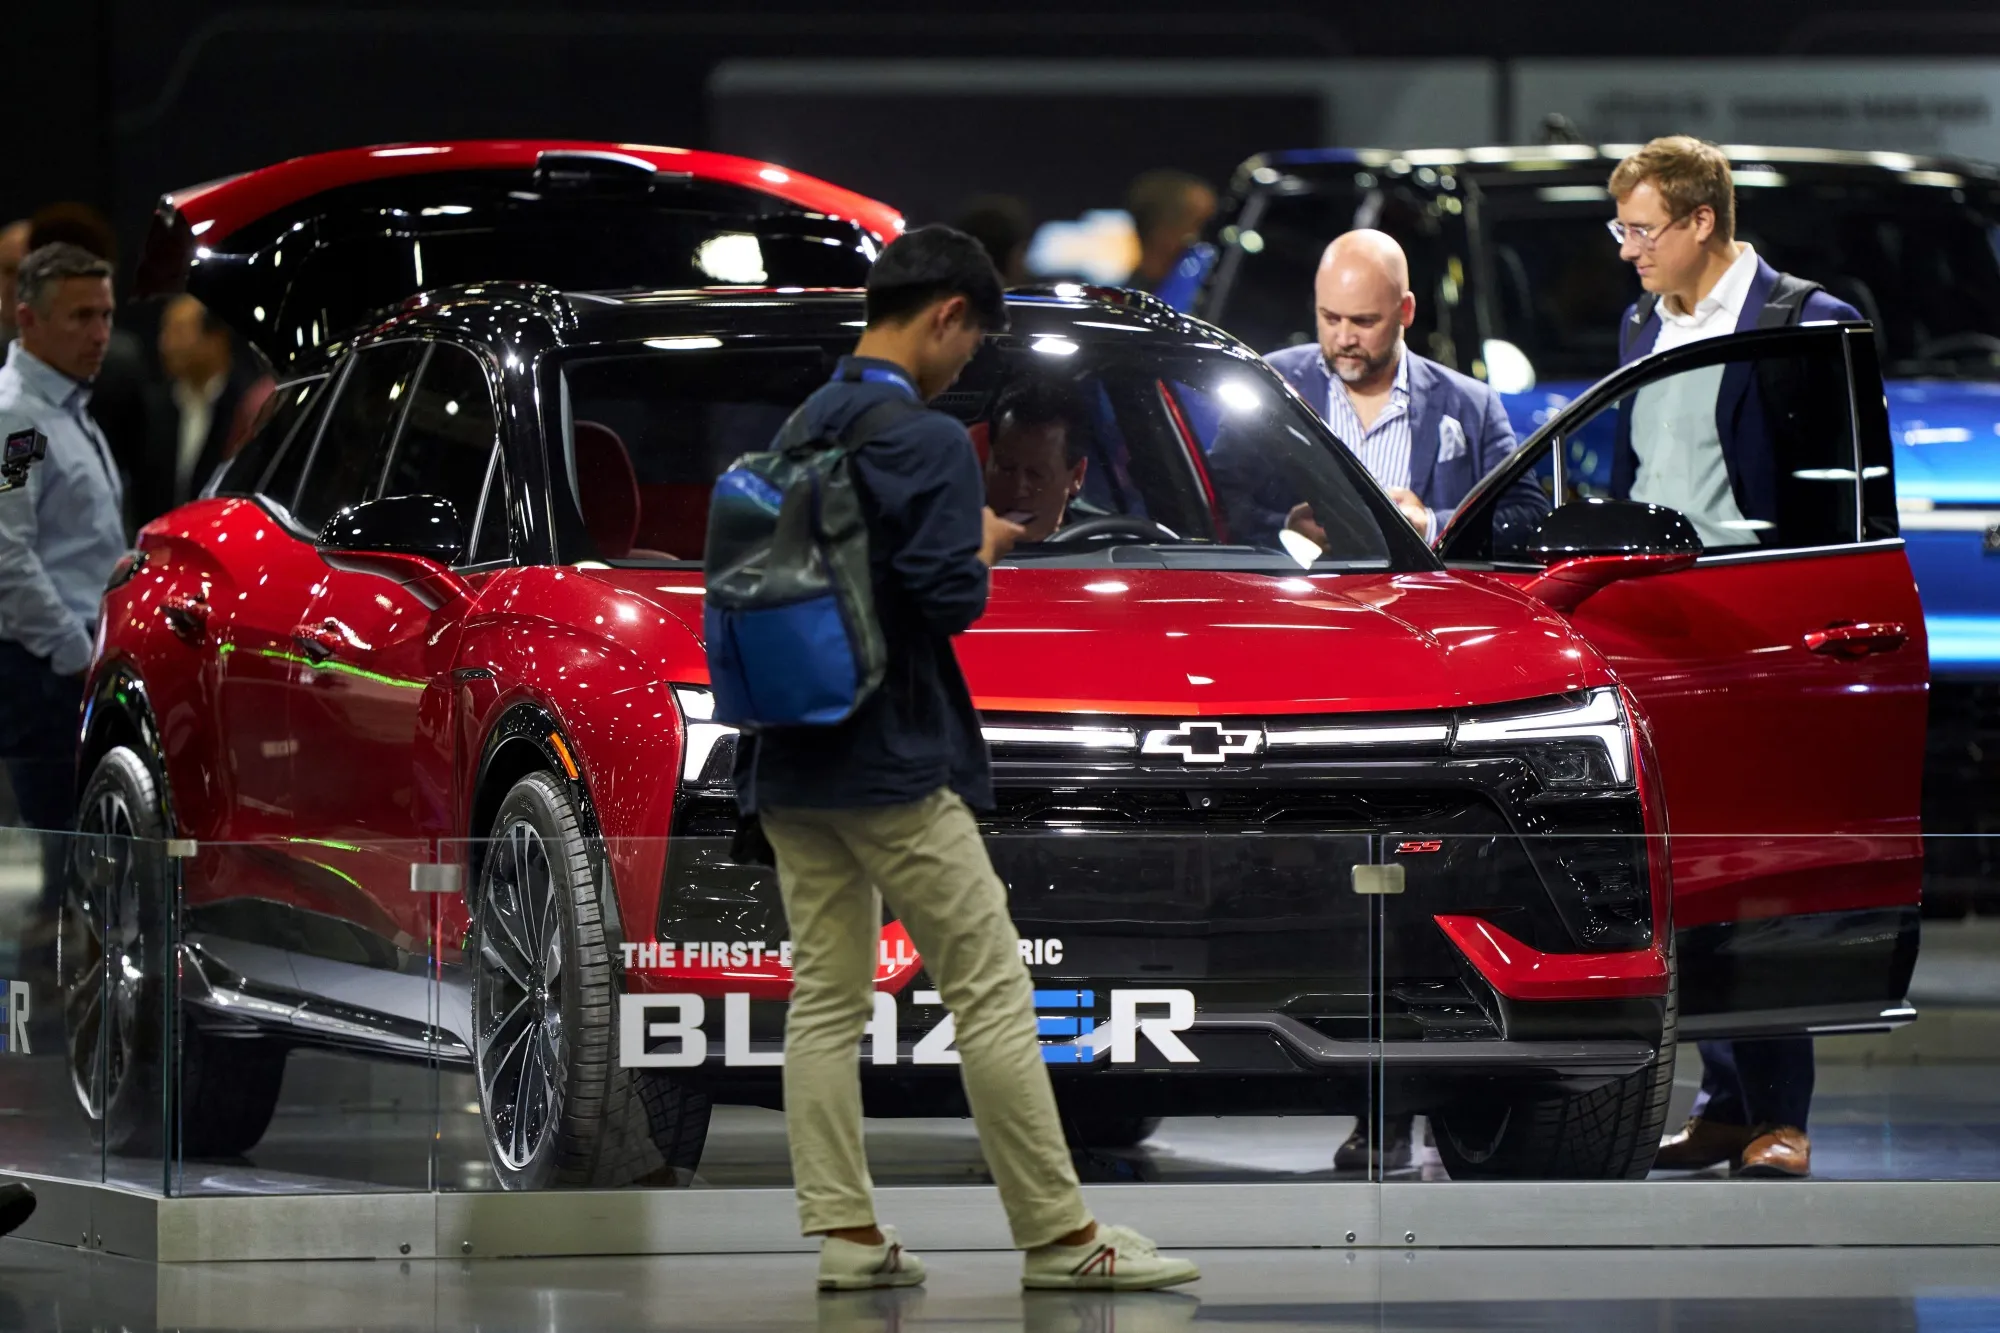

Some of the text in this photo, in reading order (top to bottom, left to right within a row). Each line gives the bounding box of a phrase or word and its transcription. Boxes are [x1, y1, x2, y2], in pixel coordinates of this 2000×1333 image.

[1395, 839, 1443, 853] SS
[619, 942, 676, 968] THE
[683, 941, 793, 968] FIRST-E
